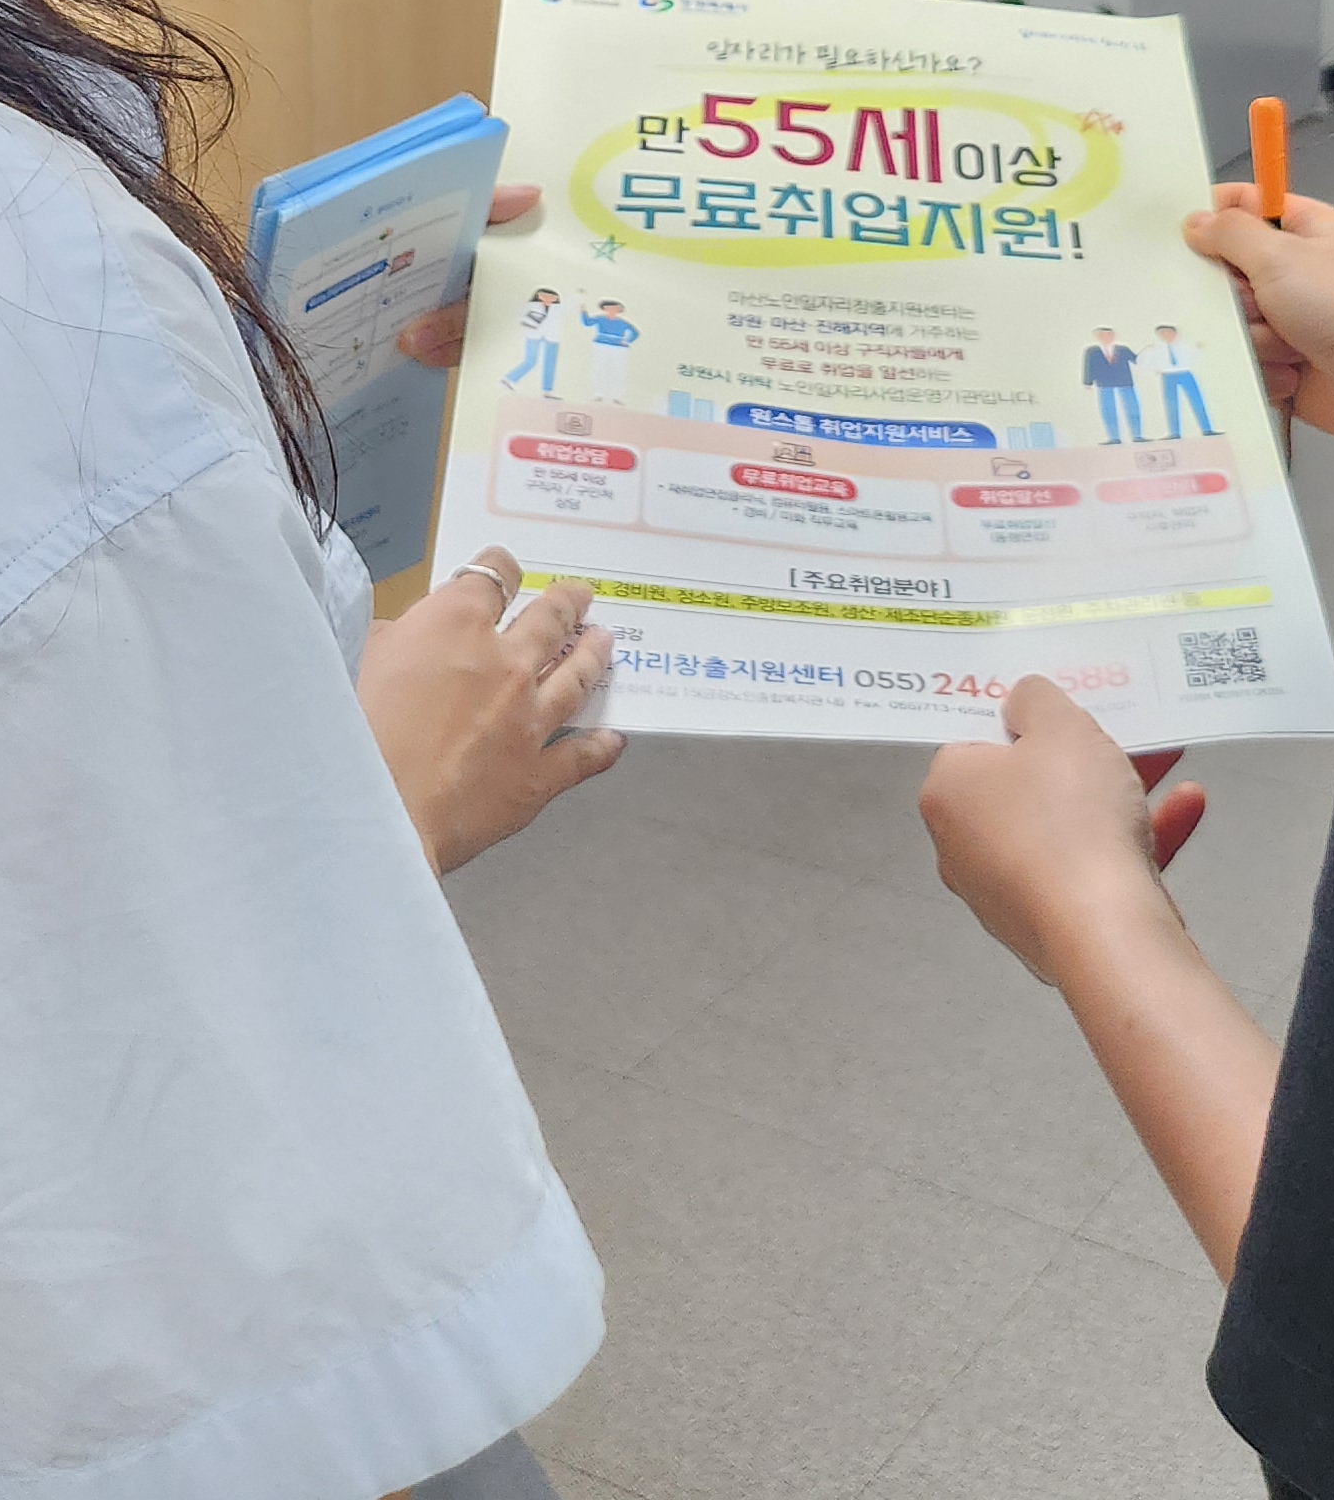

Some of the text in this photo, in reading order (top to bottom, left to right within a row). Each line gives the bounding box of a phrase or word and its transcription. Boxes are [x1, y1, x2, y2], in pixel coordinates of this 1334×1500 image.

[615, 172, 1085, 261] 무료취업지원!
[748, 406, 976, 445] 원스톱 취업지원서비스
